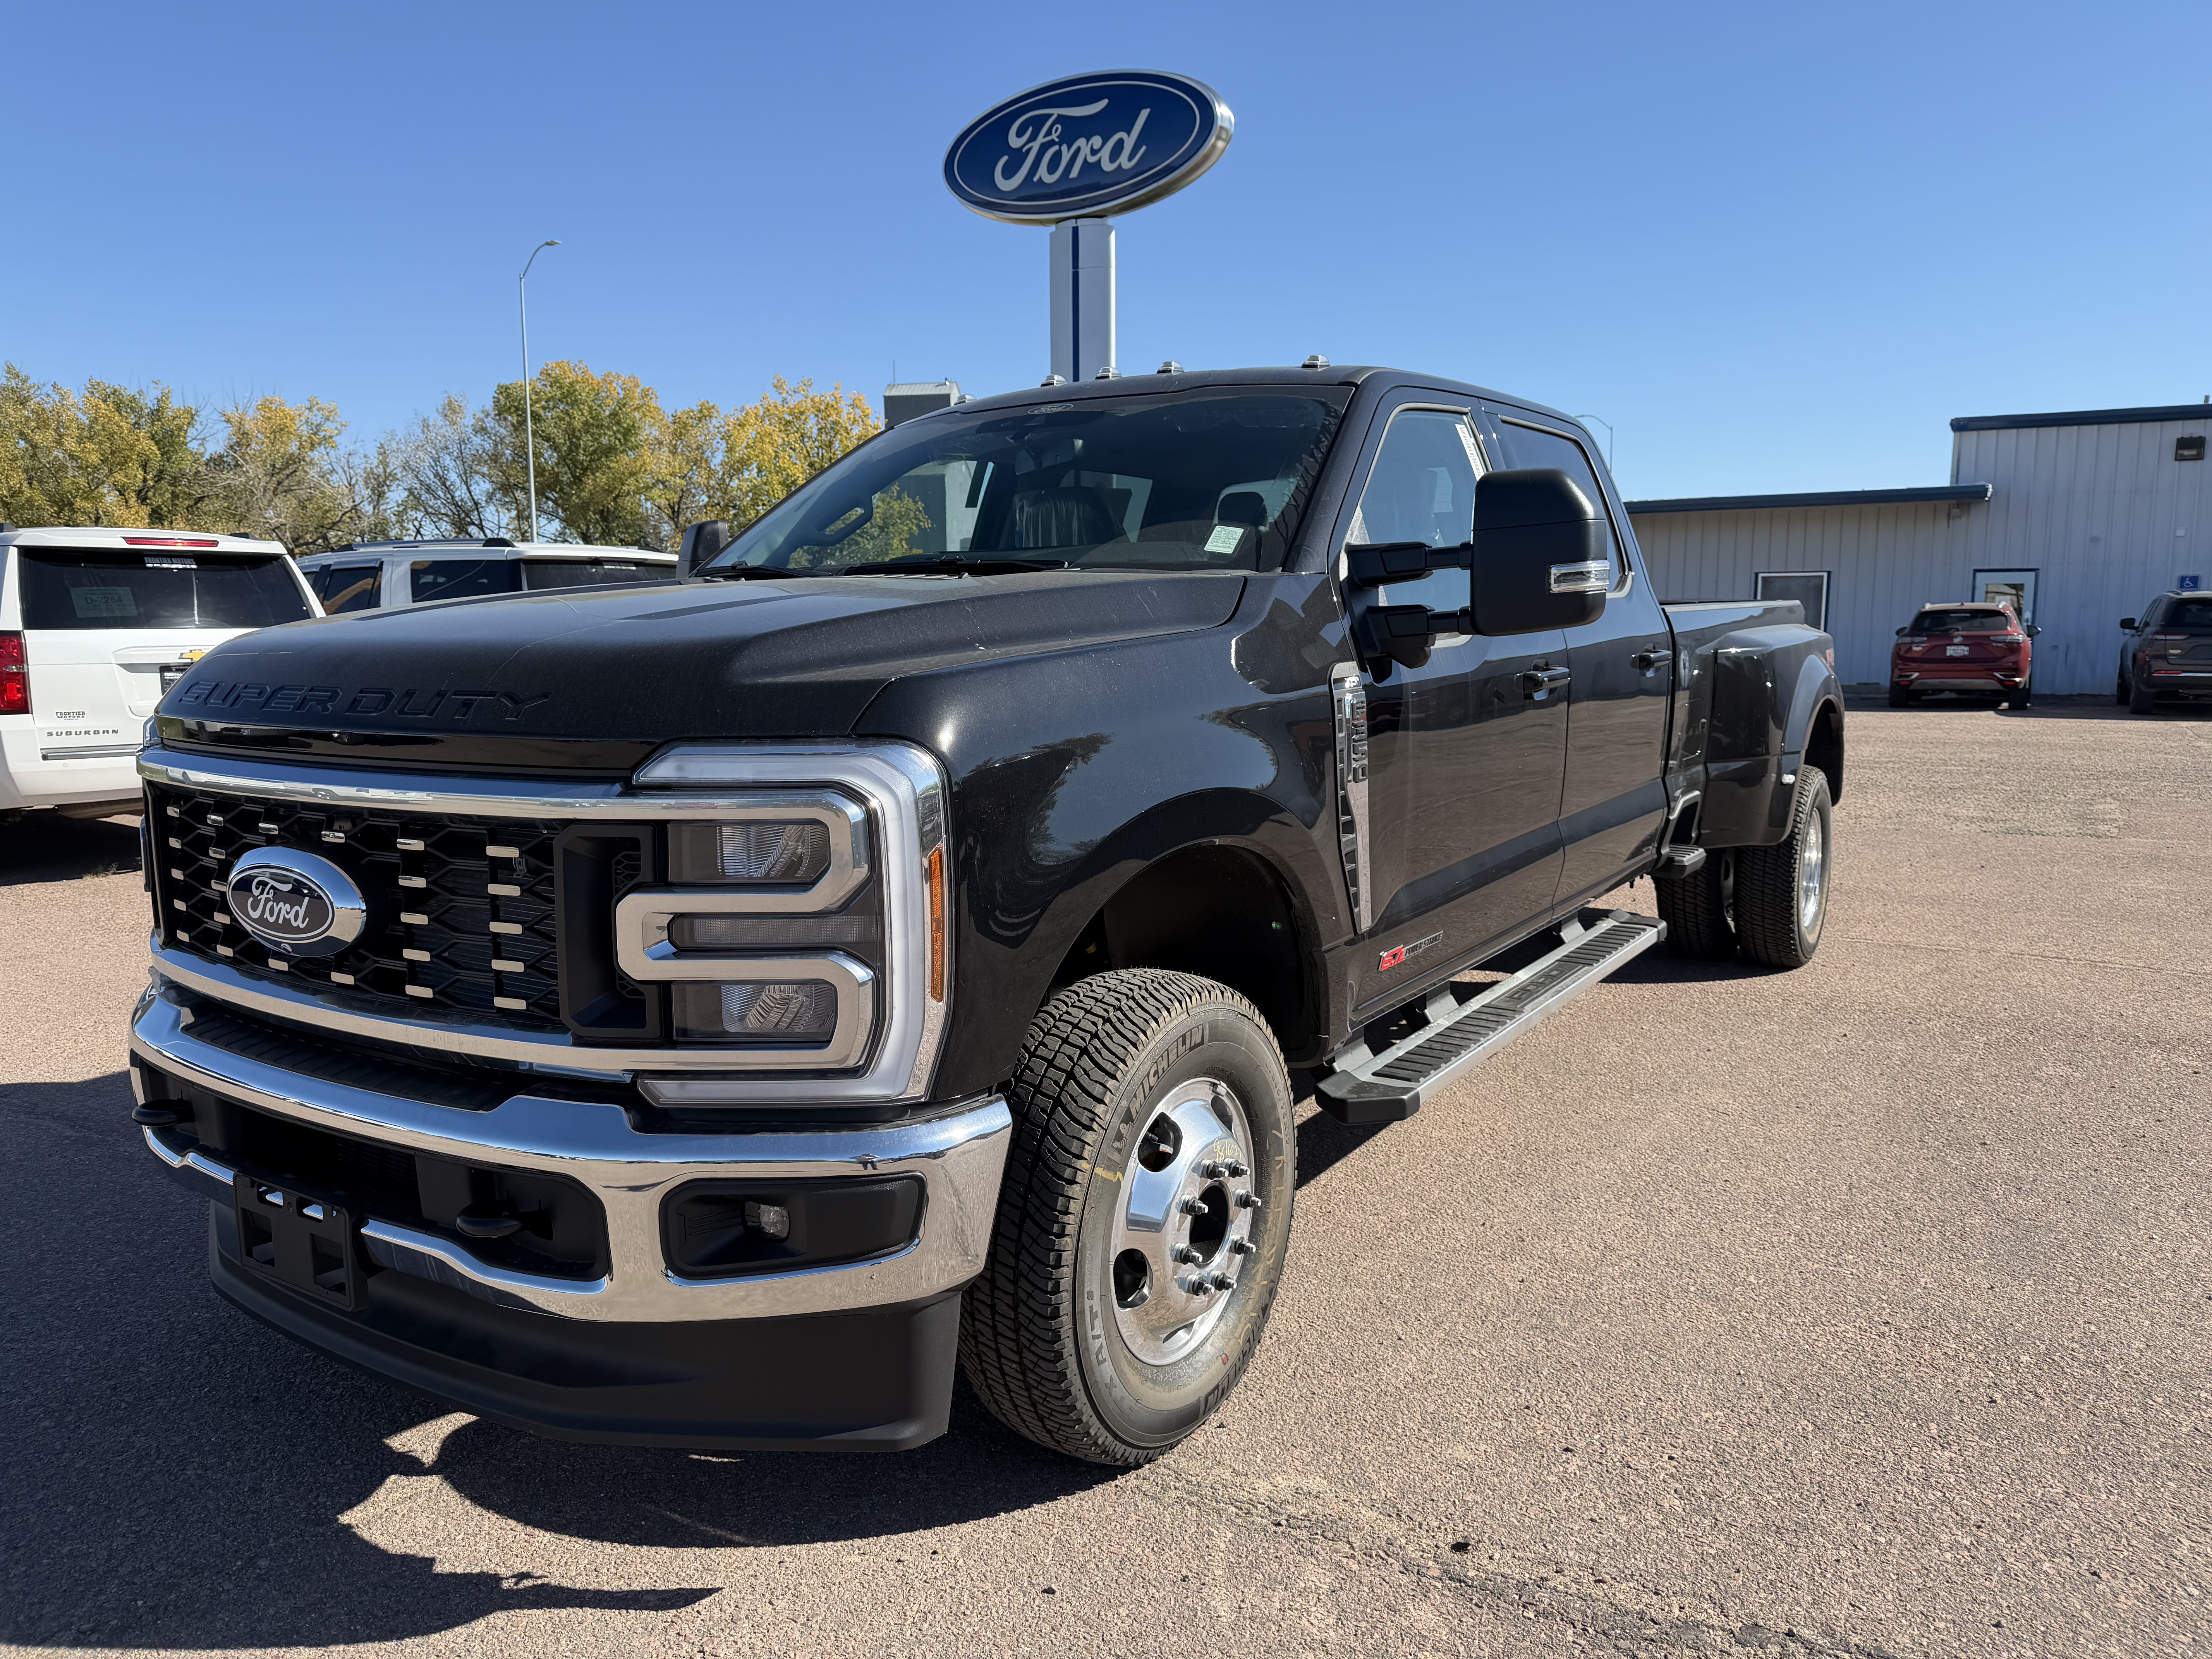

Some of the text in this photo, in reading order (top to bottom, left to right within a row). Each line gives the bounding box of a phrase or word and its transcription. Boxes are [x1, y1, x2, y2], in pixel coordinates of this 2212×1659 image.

[994, 98, 1151, 191] Ford
[178, 681, 553, 720] SUPER DUTY
[247, 876, 309, 928] Ford
[1130, 1025, 1203, 1121] MICHELIN
